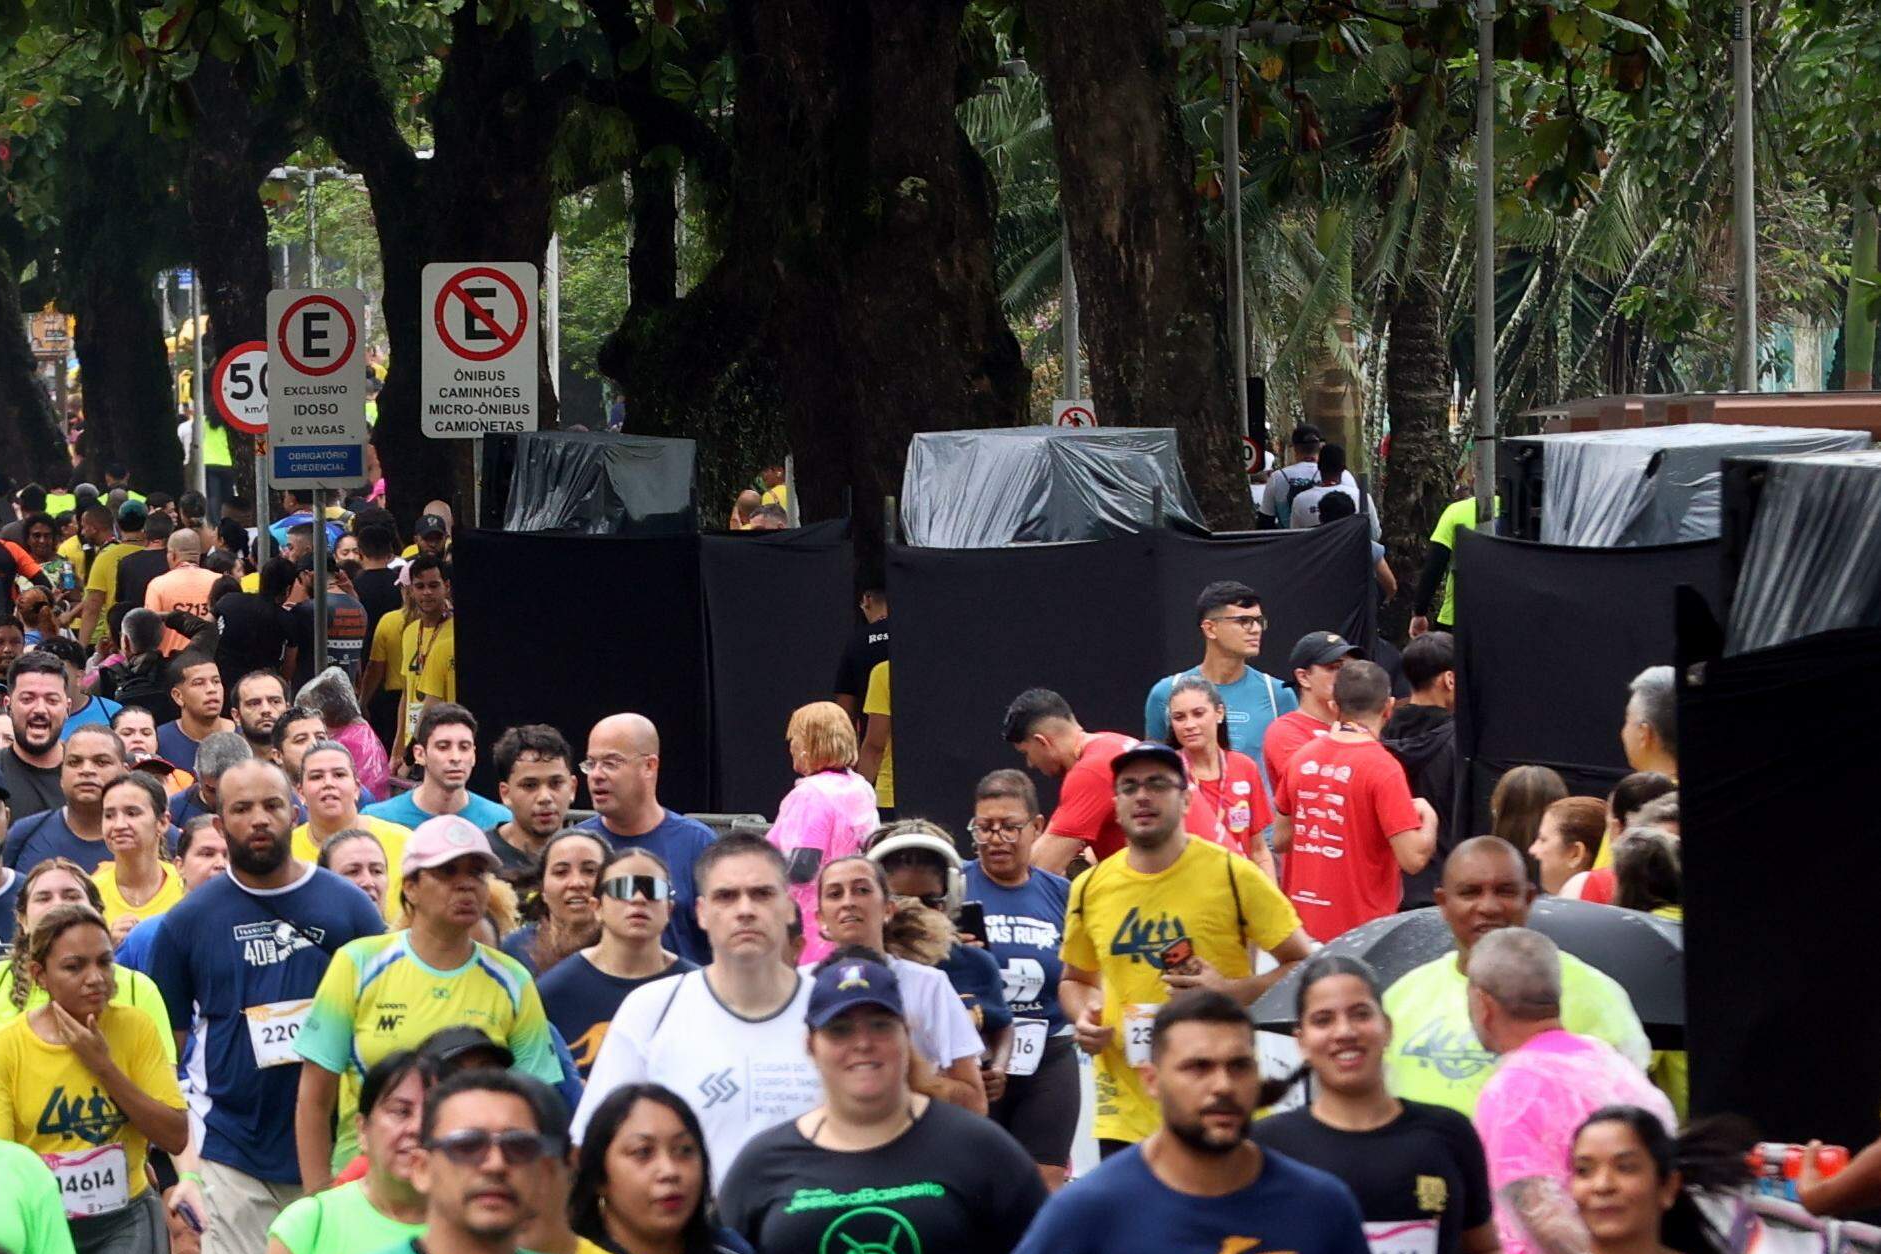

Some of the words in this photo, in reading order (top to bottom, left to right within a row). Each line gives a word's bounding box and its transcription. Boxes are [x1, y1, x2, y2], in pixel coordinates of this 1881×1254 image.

[464, 287, 498, 341] E
[302, 311, 331, 358] E
[453, 368, 506, 382] ÔNIBUS
[283, 385, 349, 397] EXCLUSIVO
[438, 384, 521, 399] CAMINHÕES
[293, 403, 339, 416] IDOSO
[428, 401, 531, 416] MICRO-ÔNIBUS
[290, 425, 304, 436] 02
[306, 424, 346, 435] VAGAS
[434, 419, 525, 433] CAMIONETAS
[290, 463, 346, 472] CREDENCIAL
[56, 1167, 116, 1195] 14614
